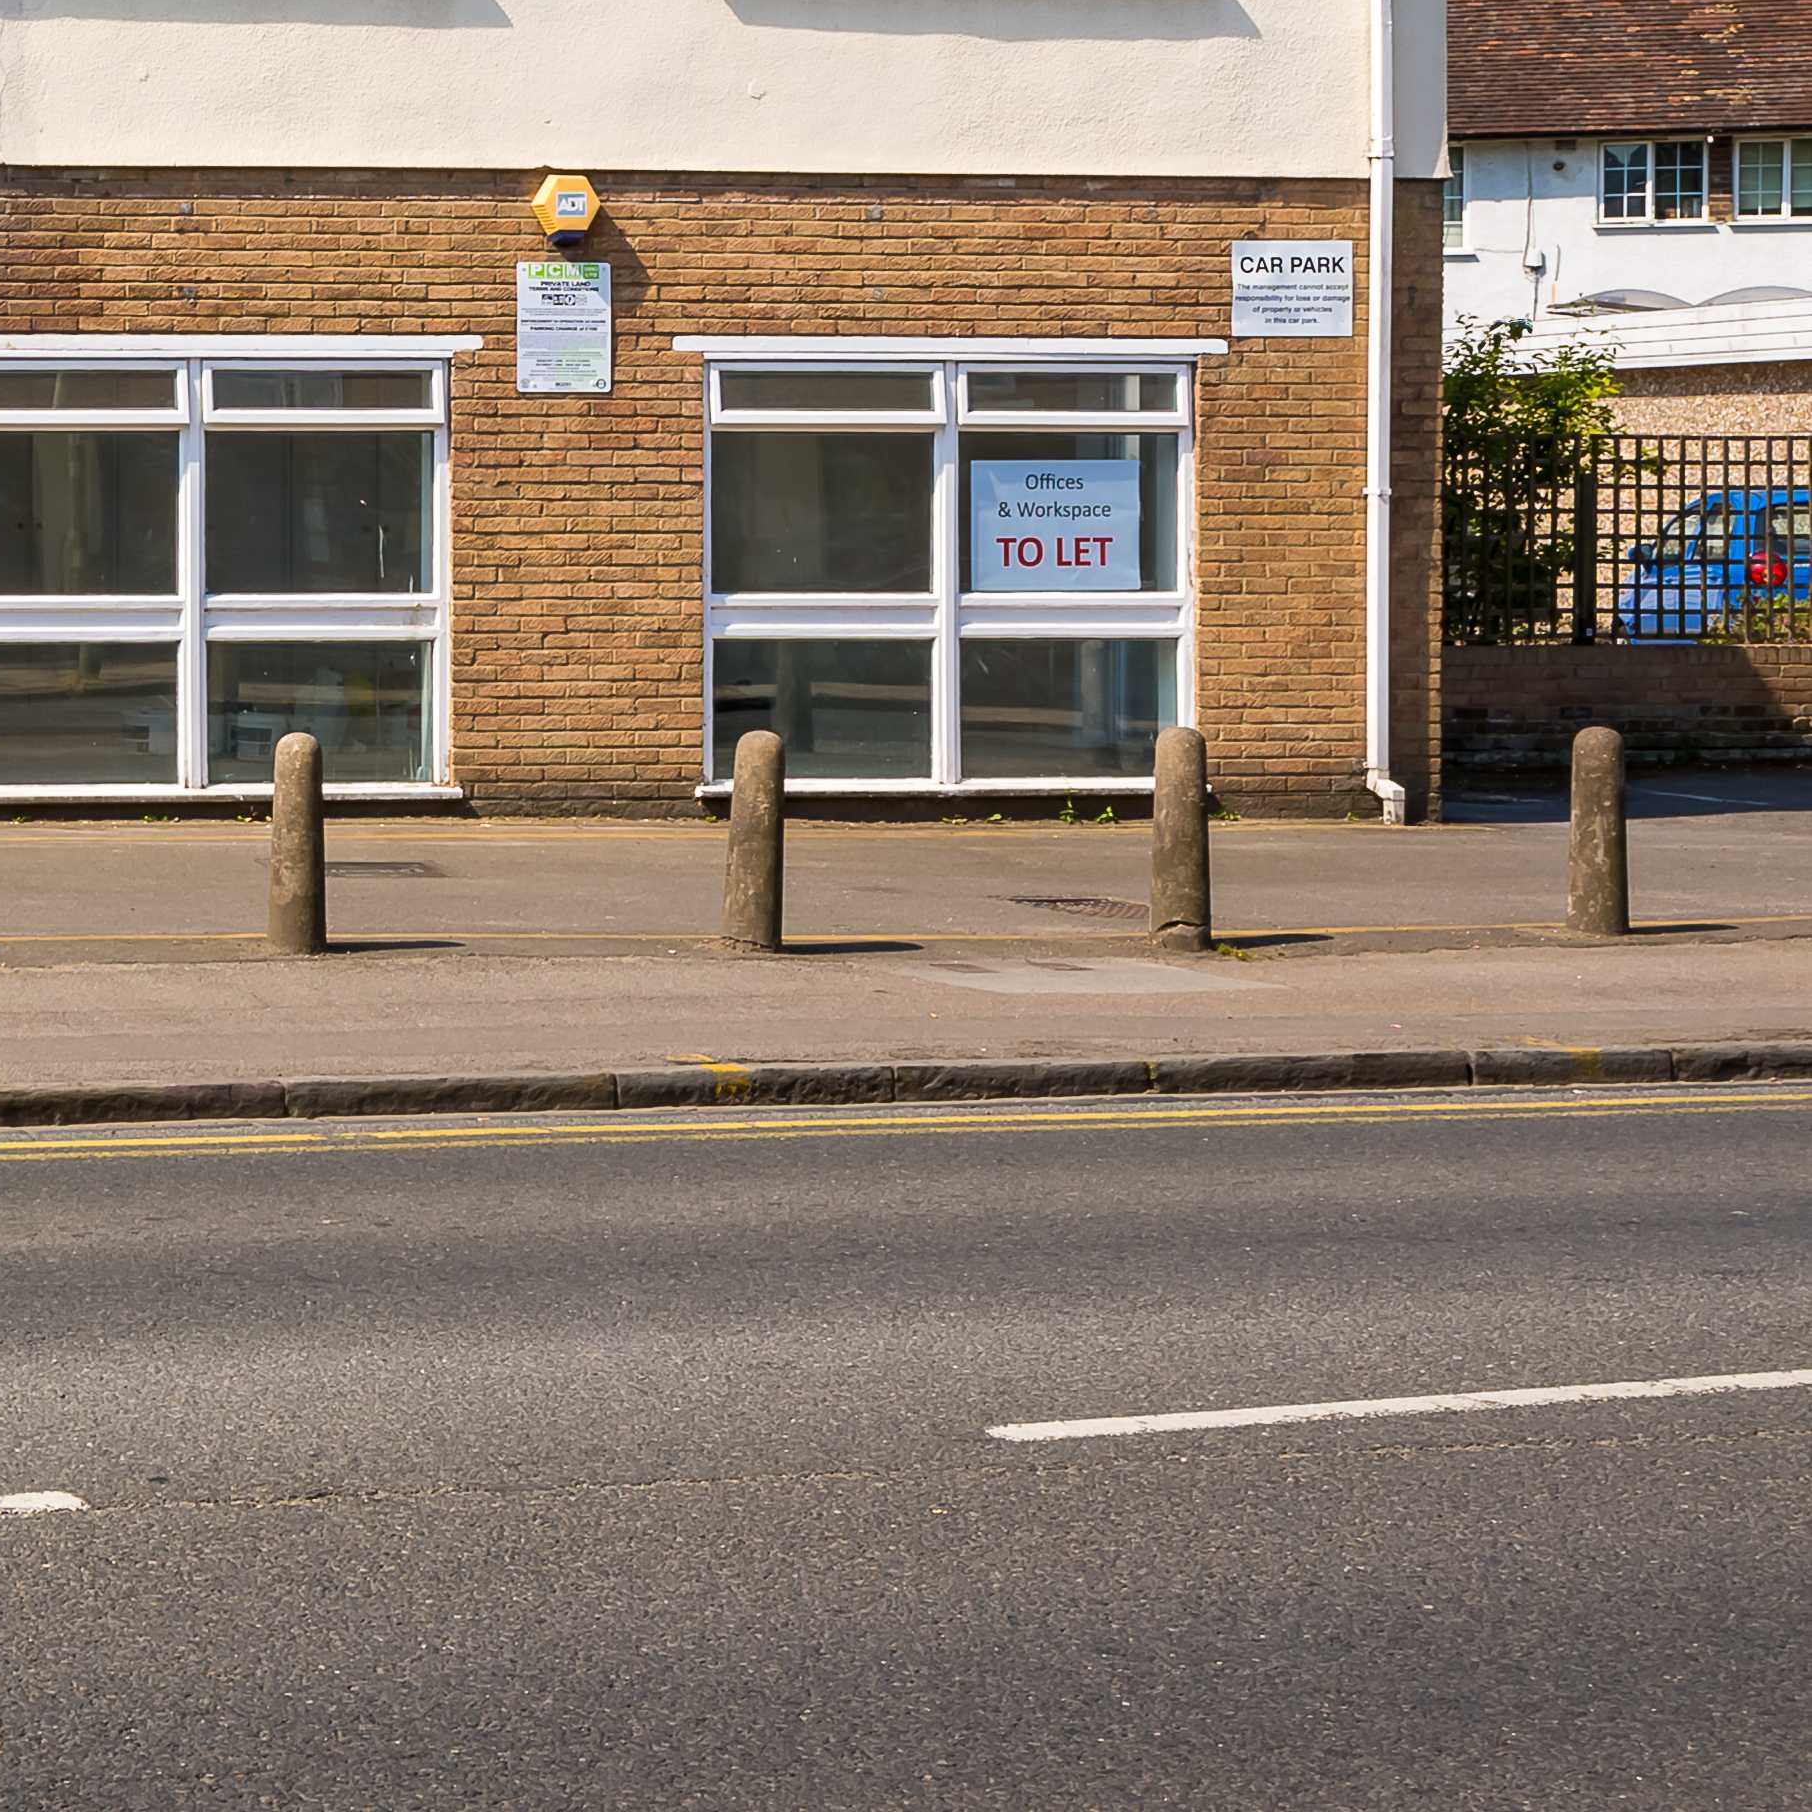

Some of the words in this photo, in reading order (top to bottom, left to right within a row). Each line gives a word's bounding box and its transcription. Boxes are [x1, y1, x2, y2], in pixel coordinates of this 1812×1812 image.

[559, 197, 586, 211] ADT
[528, 264, 581, 279] PCM
[1241, 257, 1282, 273] CAR
[1291, 257, 1345, 273] PARK
[1322, 295, 1350, 303] damage
[1025, 473, 1083, 490] Offices
[998, 502, 1011, 517] &
[1017, 501, 1111, 520] Workspace
[996, 537, 1043, 567] TO
[1057, 537, 1113, 566] LET
